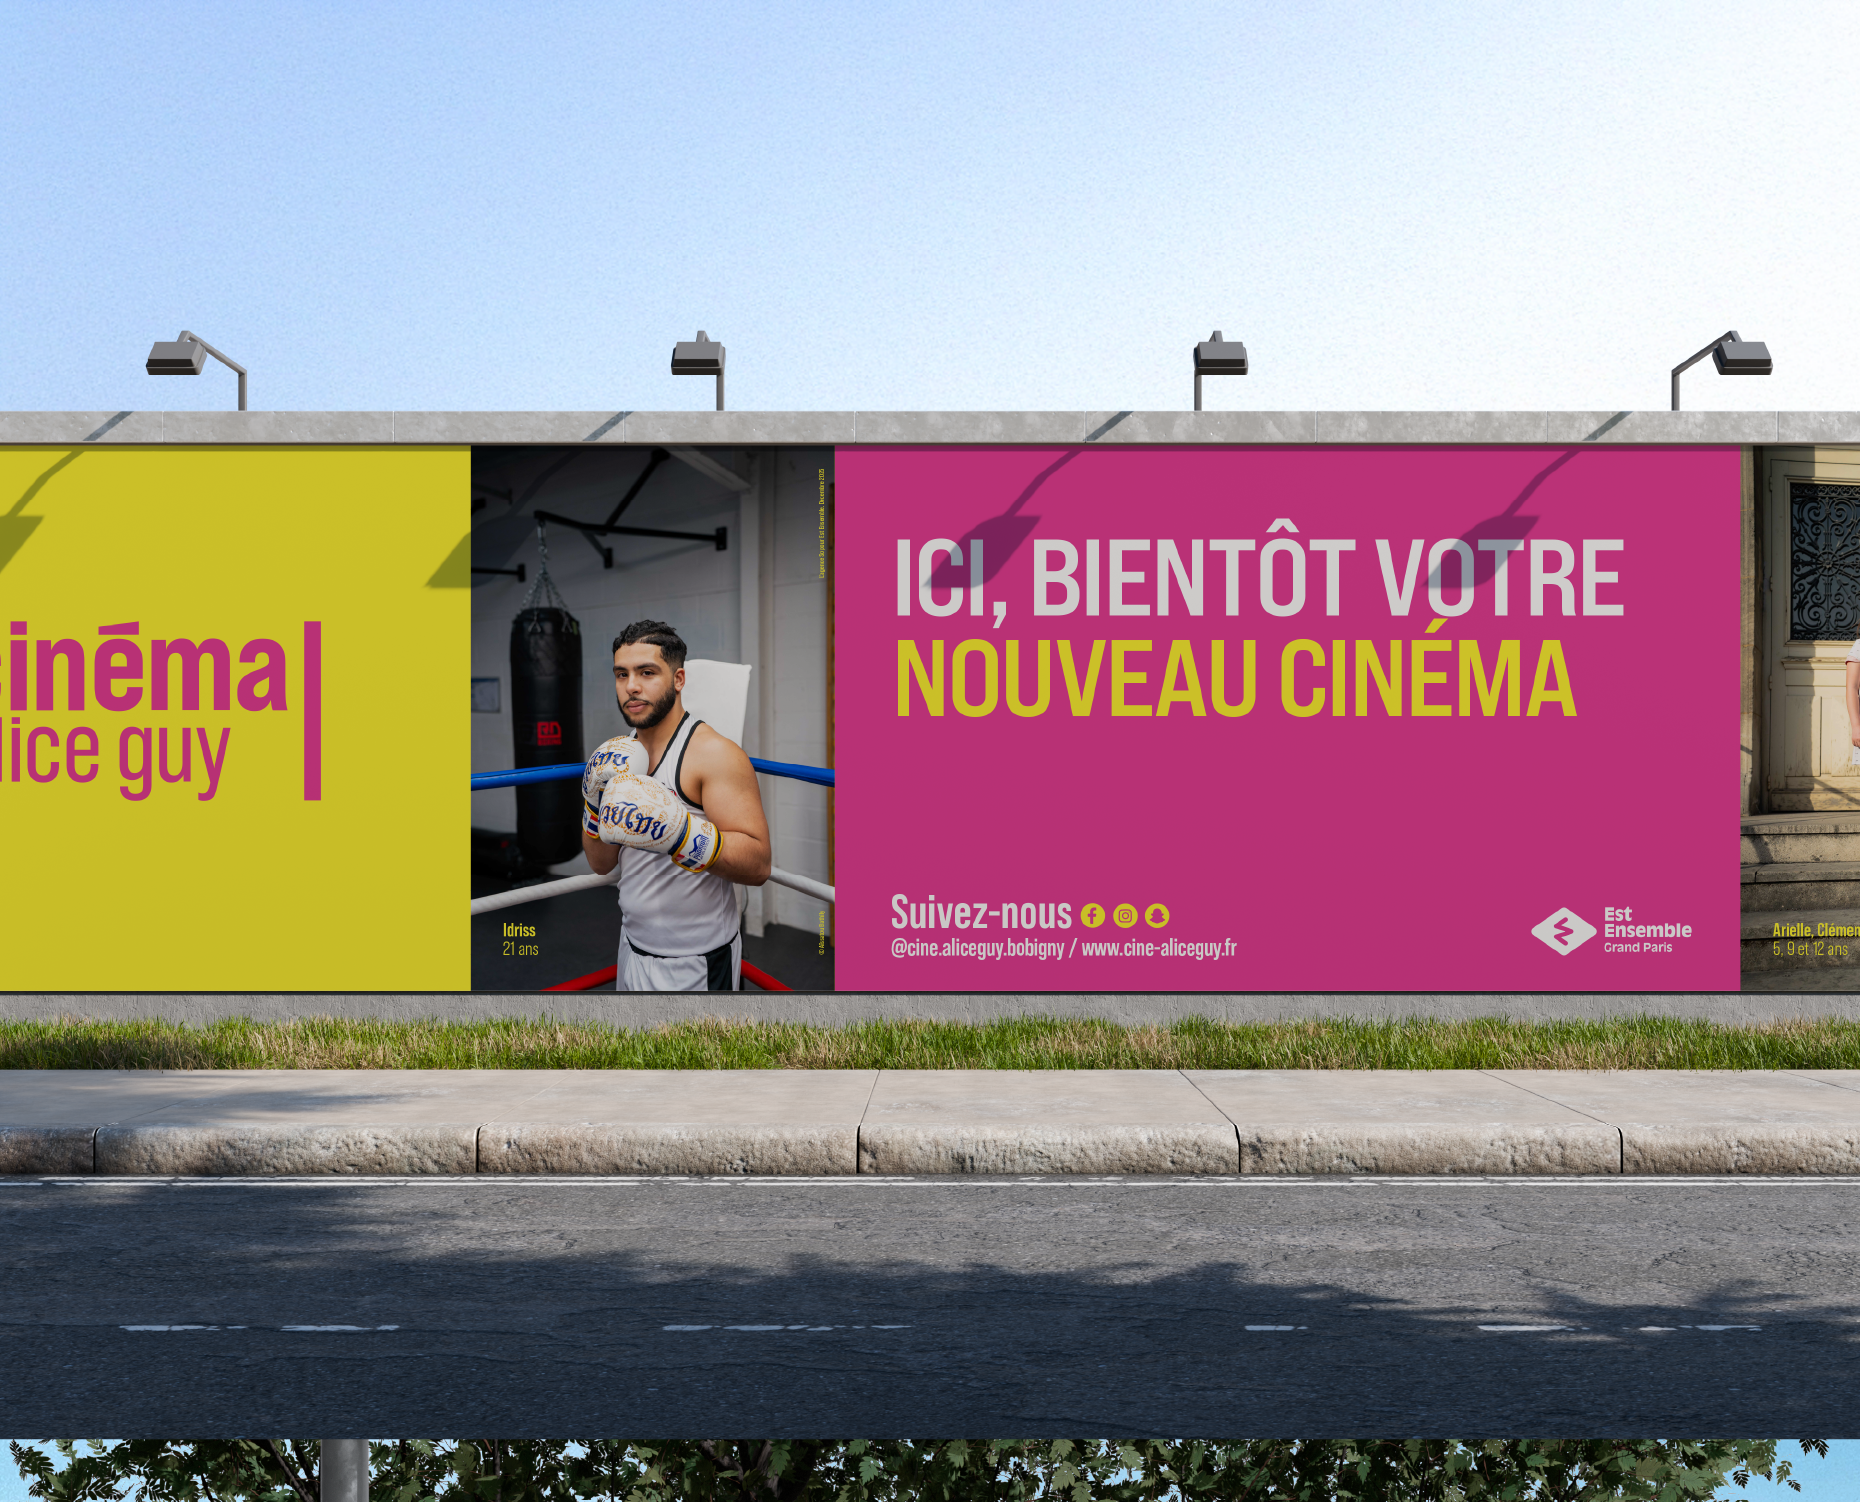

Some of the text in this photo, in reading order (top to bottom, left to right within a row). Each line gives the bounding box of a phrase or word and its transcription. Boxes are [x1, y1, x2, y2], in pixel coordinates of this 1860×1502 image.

[897, 517, 1624, 629] ICI, BIENTÔT VOTRE
[0, 621, 288, 712] inéma
[897, 618, 1578, 718] NOUVEAU CINÉMA
[0, 716, 231, 801] ice guy
[891, 893, 1072, 930] Suivez-nous
[1604, 906, 1633, 922] Est
[503, 922, 536, 937] Idriss
[1604, 922, 1693, 938] Ensemble
[1773, 922, 1814, 939] Arielle,
[502, 941, 539, 956] 21 ans
[891, 937, 1065, 961] @cine.aliceguy.bobigny
[1081, 937, 1238, 961] www.cine-aliceguy.fr
[1604, 941, 1673, 953] Grand Paris
[1773, 941, 1849, 957] 5, 9 et 12 ans
